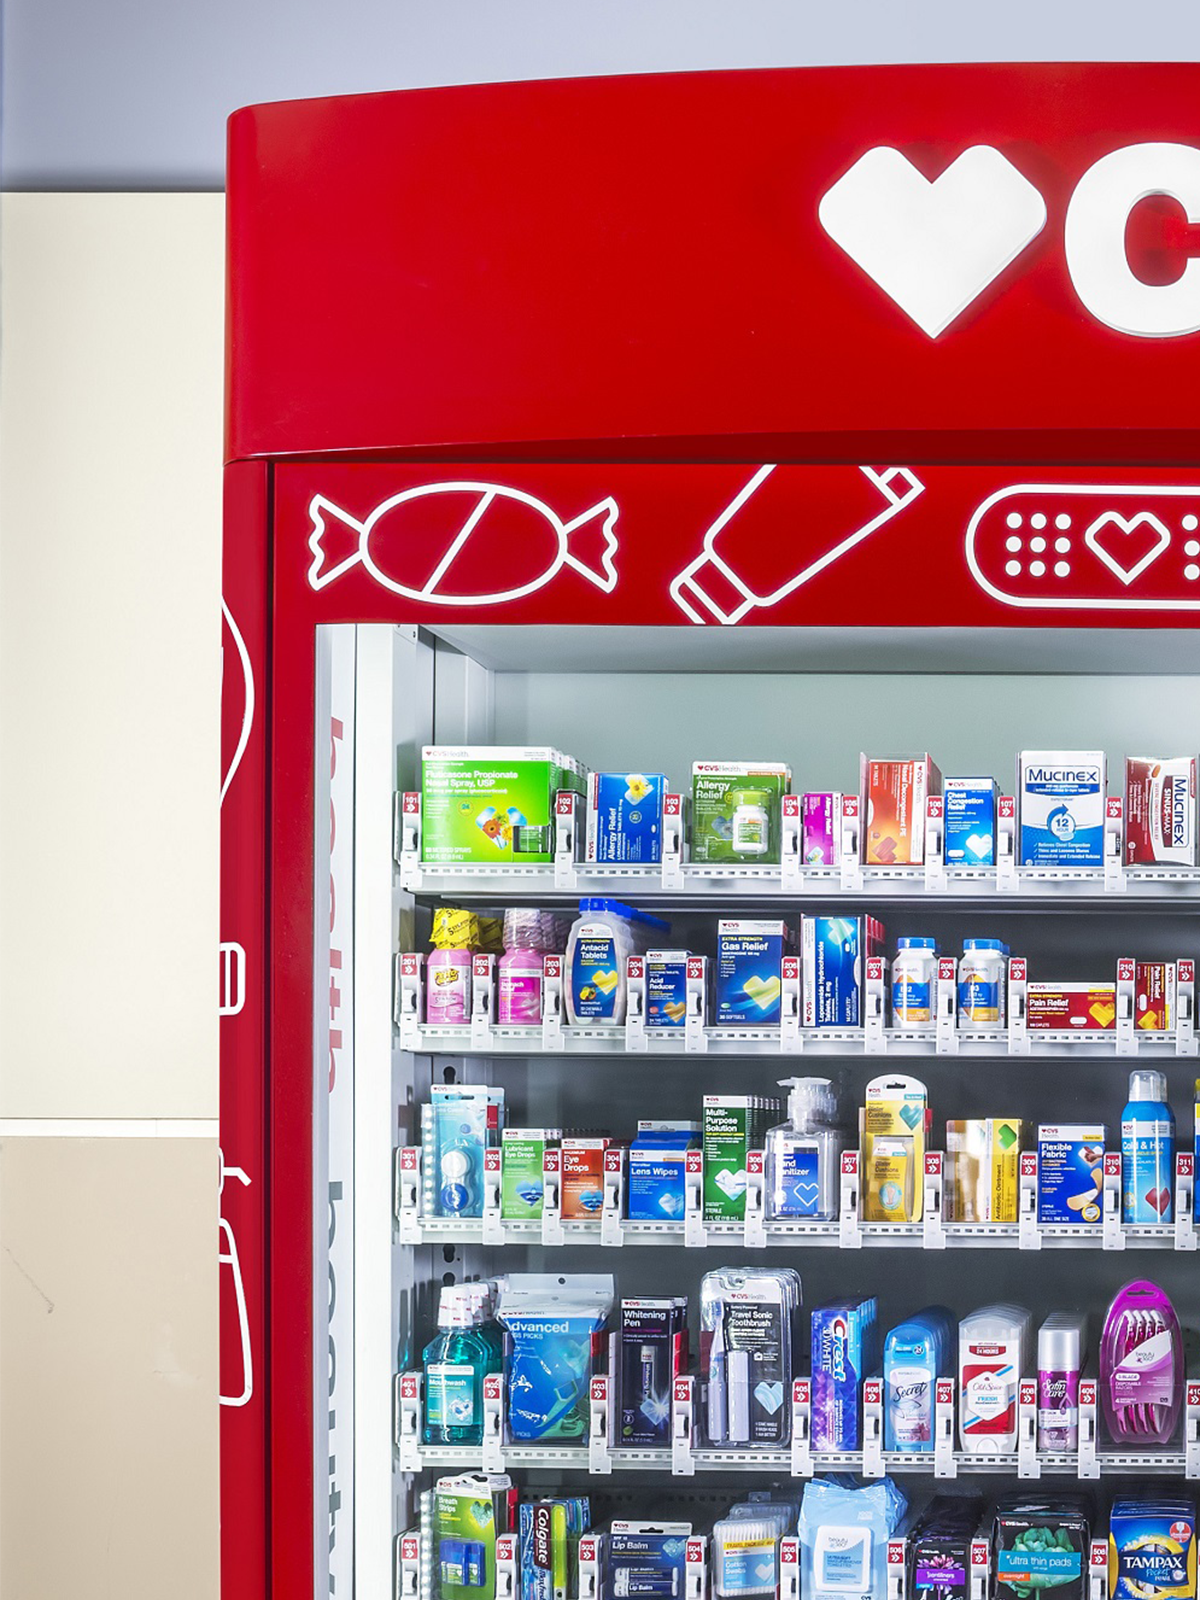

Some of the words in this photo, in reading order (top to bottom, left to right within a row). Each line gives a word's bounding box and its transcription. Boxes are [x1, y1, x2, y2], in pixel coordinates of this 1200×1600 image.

[474, 771, 518, 779] Propionate
[1029, 768, 1097, 782] Mucinex
[450, 779, 475, 788] Spray,
[478, 779, 495, 787] USP
[696, 781, 730, 791] Allergy
[696, 791, 723, 799] Relief
[559, 797, 571, 805] 102
[899, 783, 907, 826] Decongestant
[1174, 779, 1186, 845] Mucinex
[1056, 819, 1068, 827] 12
[900, 828, 906, 836] PE
[608, 832, 617, 859] Allergy
[722, 942, 738, 950] Gas
[741, 942, 768, 950] Relief
[706, 1117, 737, 1125] Purpose
[1042, 1143, 1072, 1151] Flexible
[564, 1156, 579, 1164] Eye
[564, 1164, 589, 1172] Drops
[624, 1310, 666, 1320] Whitening
[731, 1311, 751, 1319] Travel
[624, 1319, 640, 1327] Pen
[833, 1320, 846, 1381] Crest
[822, 1339, 831, 1371] WHITE
[894, 1382, 927, 1402] Secret
[439, 1497, 457, 1505] Breath
[439, 1505, 456, 1513] Strips
[536, 1509, 548, 1563] Colgate
[612, 1542, 624, 1550] Lip
[1010, 1557, 1029, 1566] ultra
[1031, 1557, 1047, 1566] thin
[1049, 1558, 1071, 1568] pads
[1124, 1557, 1182, 1568] TAMPAX
[1146, 1568, 1170, 1578] Pocket
